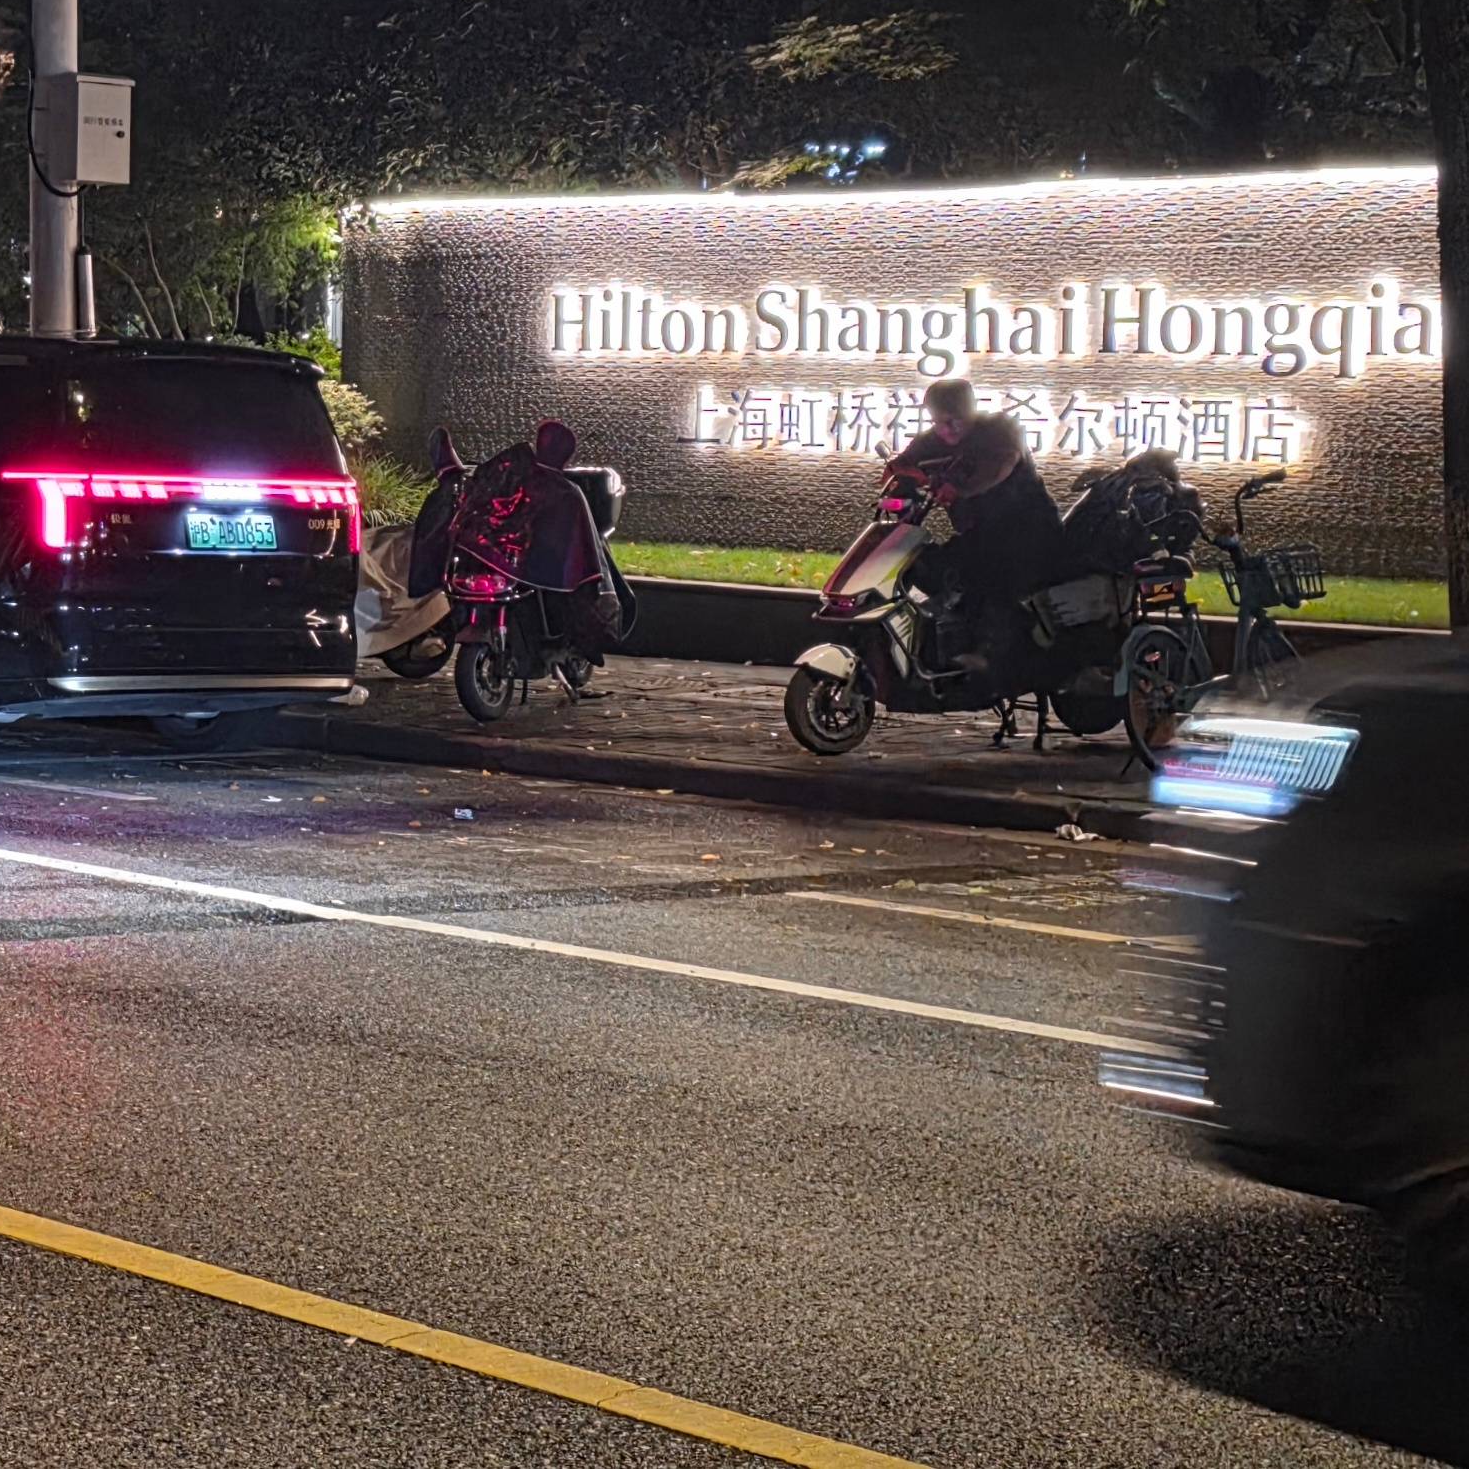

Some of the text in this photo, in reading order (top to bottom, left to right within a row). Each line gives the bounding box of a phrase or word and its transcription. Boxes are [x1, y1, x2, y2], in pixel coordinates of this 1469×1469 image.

[552, 289, 739, 354] Hilton
[755, 286, 1076, 377] Shanghai
[676, 388, 1299, 463] 上海虹桥祥希尔顿酒店
